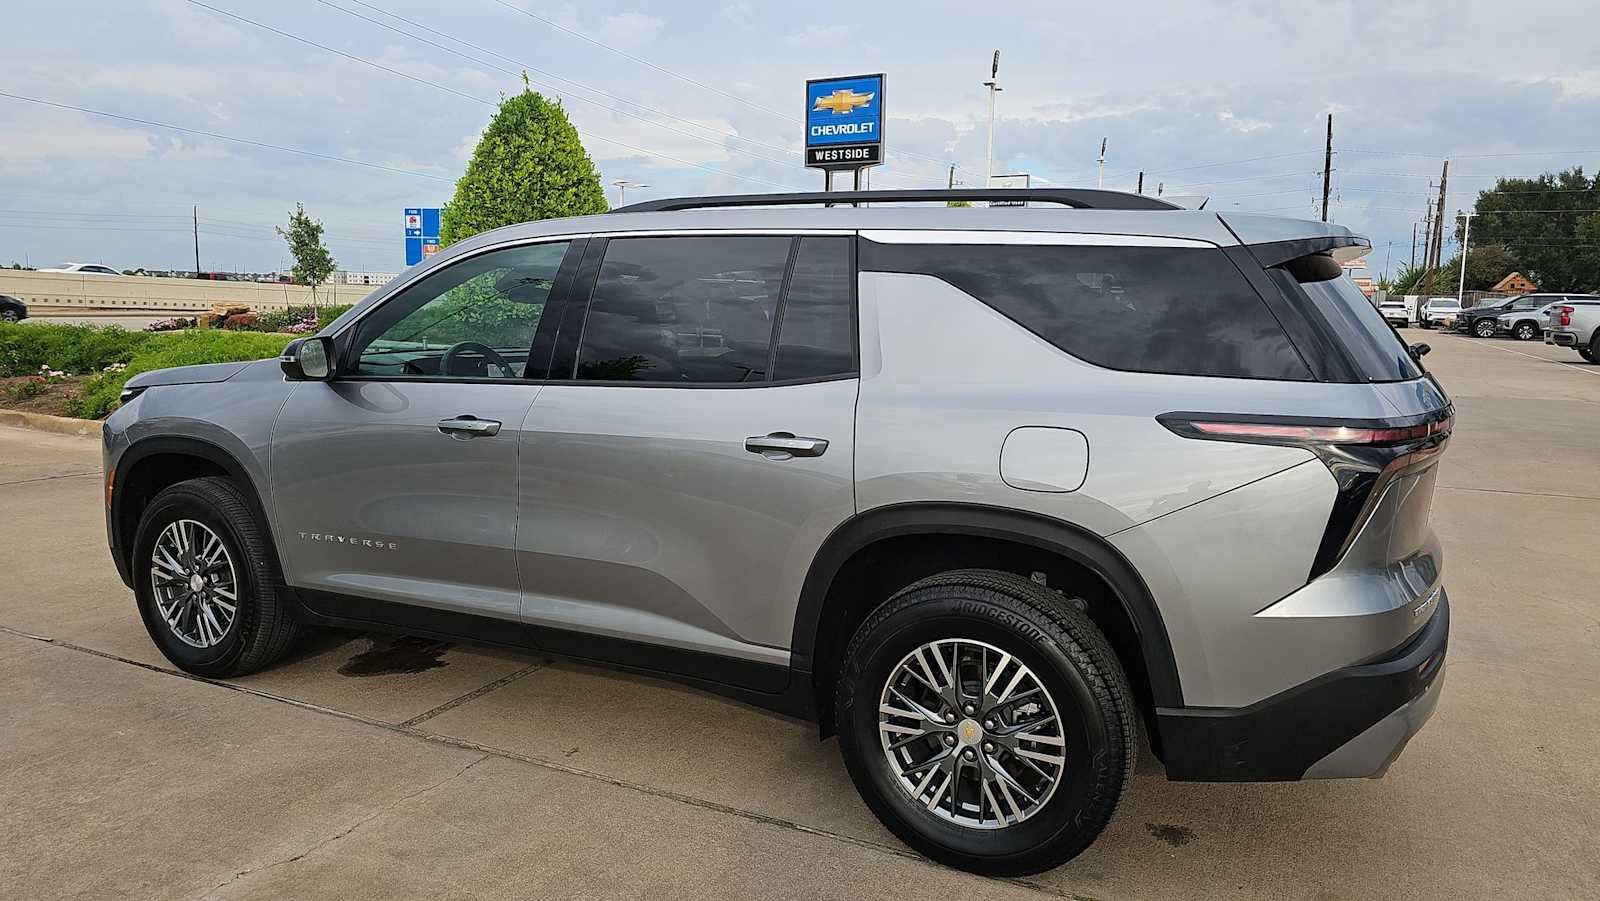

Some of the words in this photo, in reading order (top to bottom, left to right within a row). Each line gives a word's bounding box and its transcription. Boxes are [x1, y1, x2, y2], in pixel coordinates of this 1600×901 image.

[811, 122, 874, 136] CHEVROLET
[815, 148, 869, 161] WESTSIDE
[298, 531, 397, 550] TRAVERSE
[952, 601, 1047, 645] BRIDGESTONE
